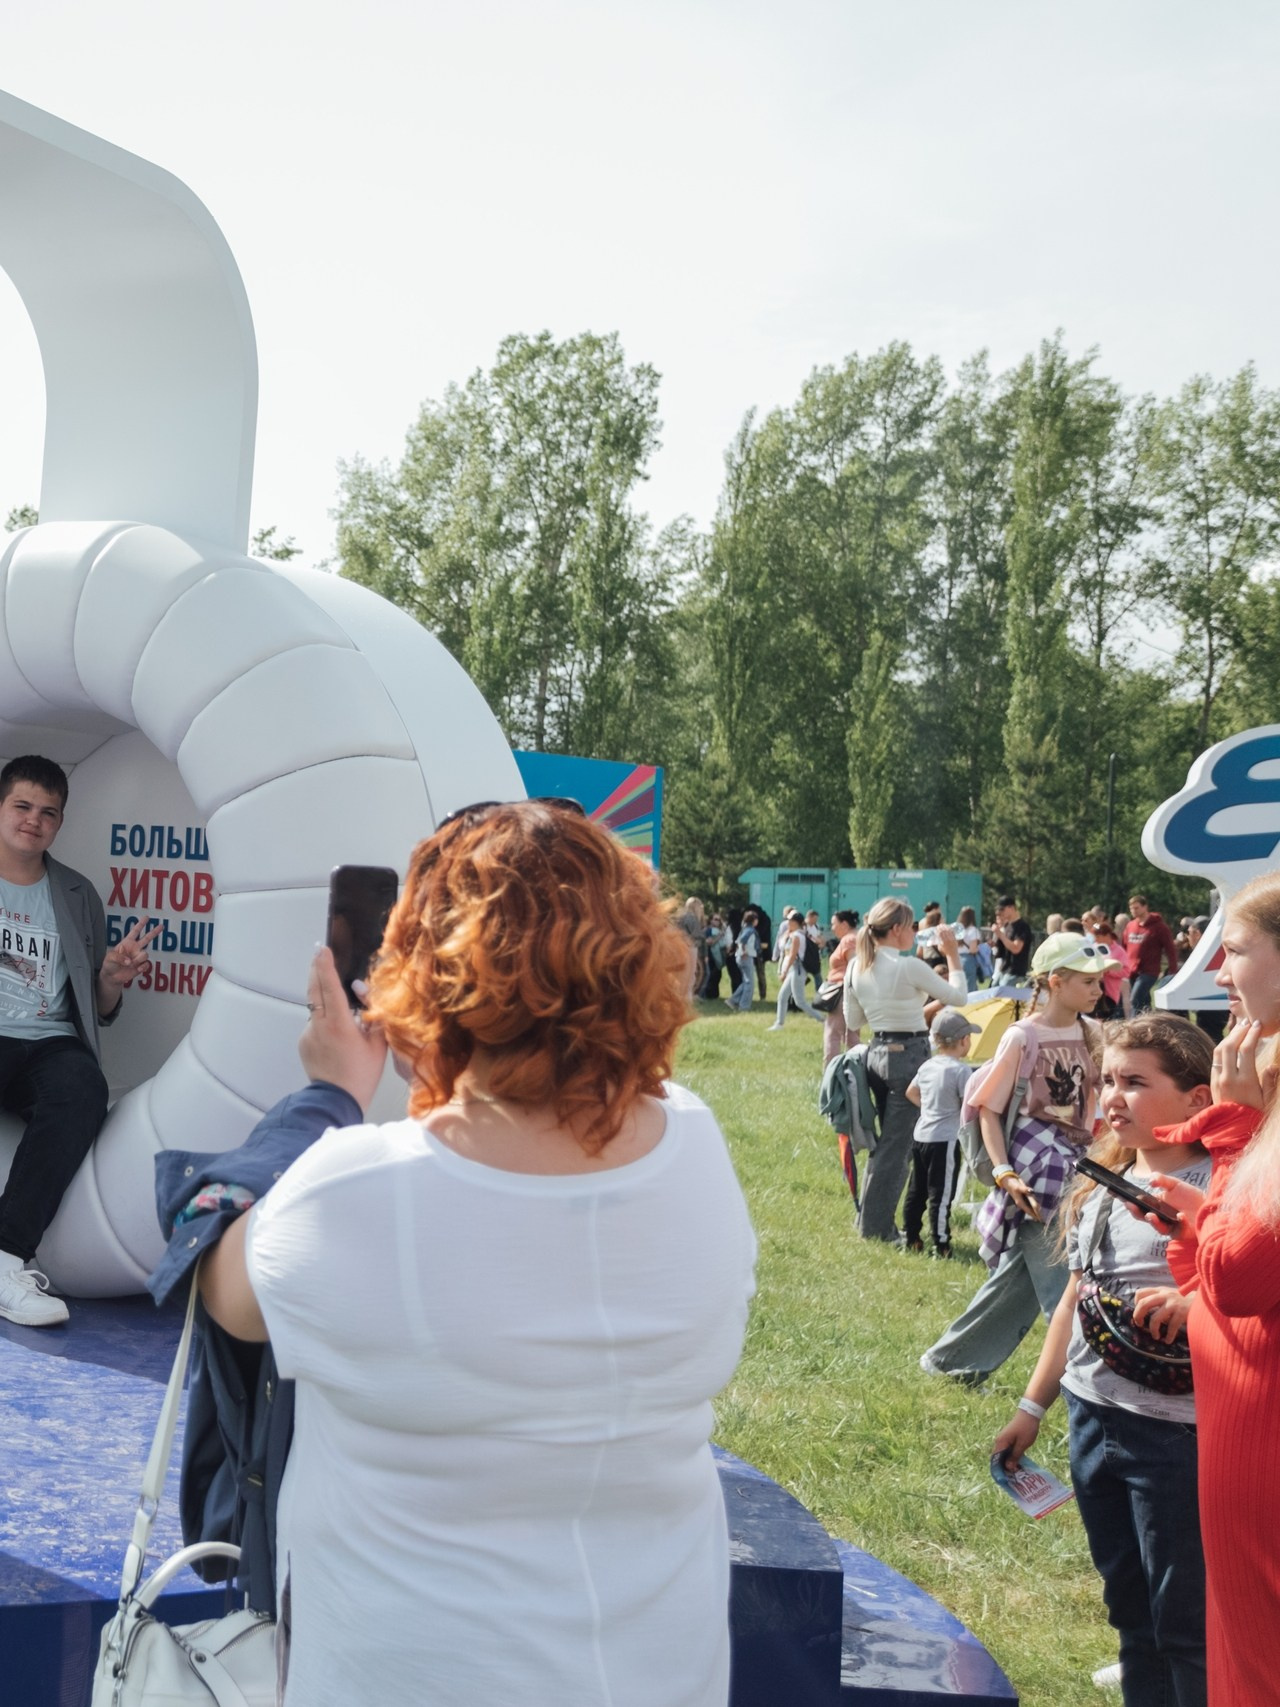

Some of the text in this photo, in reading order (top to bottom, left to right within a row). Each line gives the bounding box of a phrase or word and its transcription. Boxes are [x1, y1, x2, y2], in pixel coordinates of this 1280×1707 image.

[110, 823, 210, 861] БОЛЬШ
[107, 867, 214, 914] ХИТОВ
[107, 915, 214, 956] БОЛЬШ
[123, 959, 213, 997] ЗЫКИ
